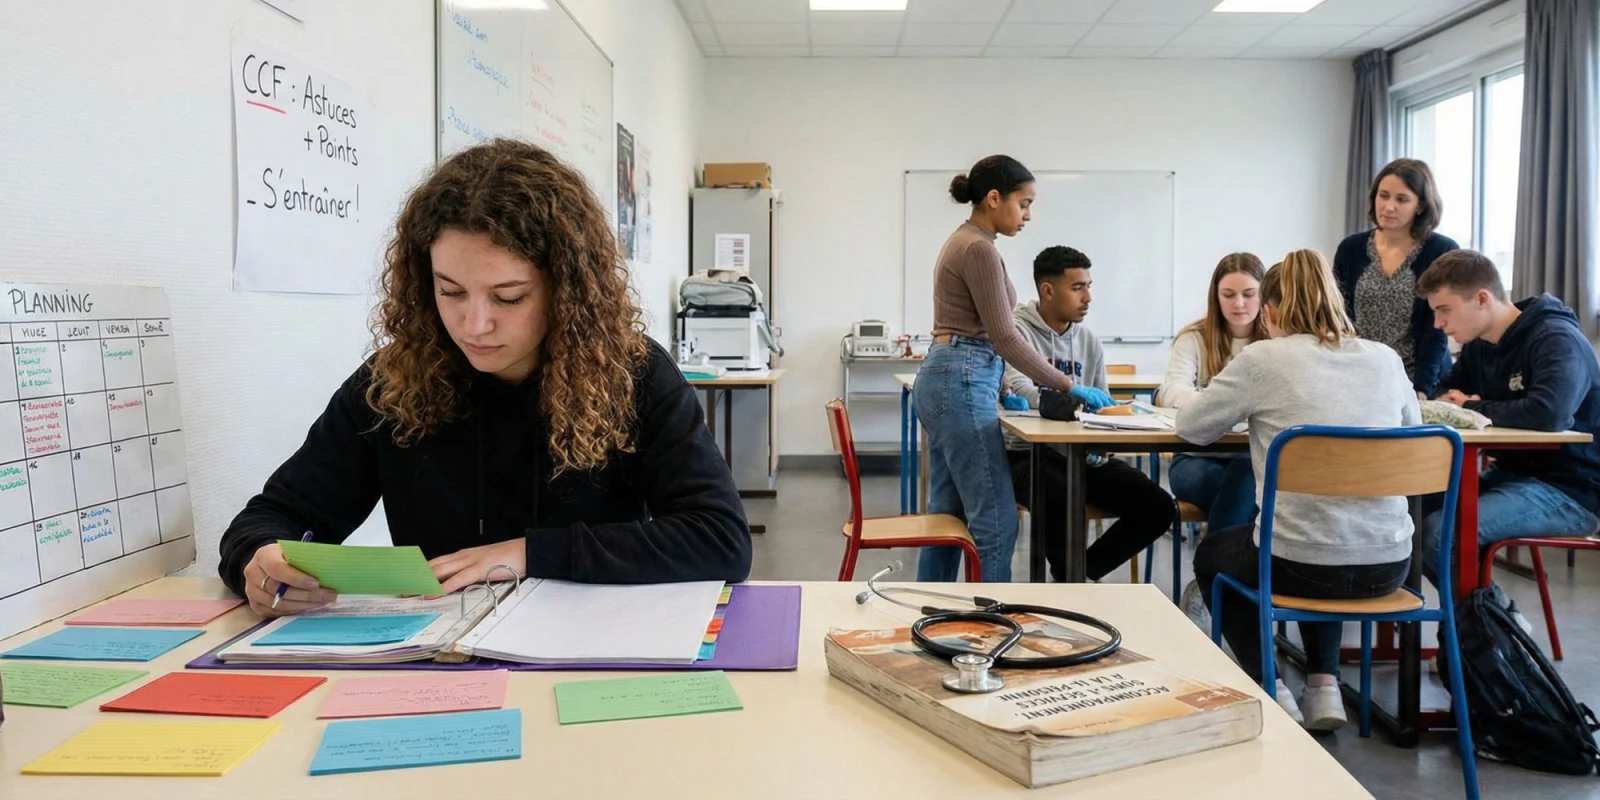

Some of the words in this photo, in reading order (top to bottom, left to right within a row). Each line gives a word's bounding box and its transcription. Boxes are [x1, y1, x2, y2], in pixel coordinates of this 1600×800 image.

[242, 54, 286, 99] CCF
[302, 75, 357, 128] Astuces
[317, 124, 358, 166] Points
[7, 288, 94, 315] PLANNING
